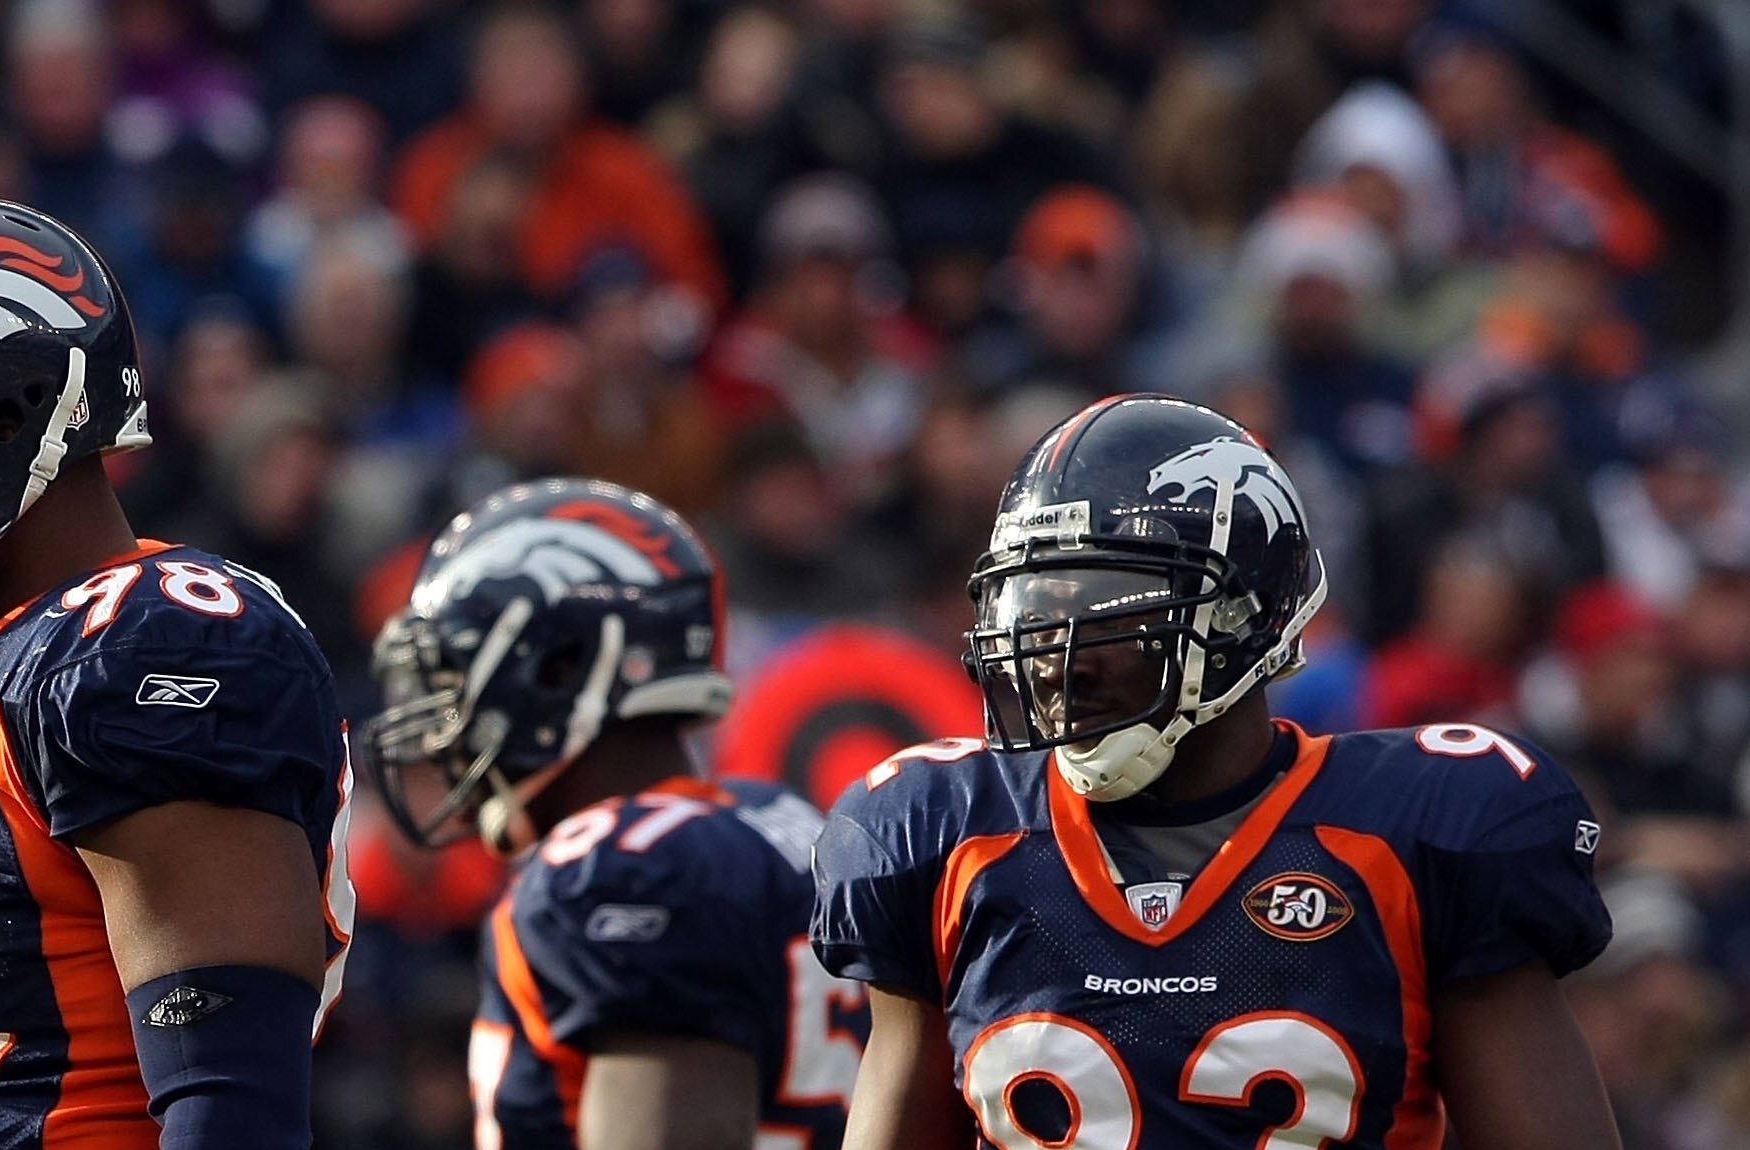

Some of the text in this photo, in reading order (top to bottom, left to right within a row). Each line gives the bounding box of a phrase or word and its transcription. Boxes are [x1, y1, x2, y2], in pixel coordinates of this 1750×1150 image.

[121, 366, 141, 398] 98
[60, 559, 246, 639] 98
[1414, 722, 1538, 782] 9
[1267, 884, 1328, 930] 50
[1084, 973, 1218, 995] BRONCOS
